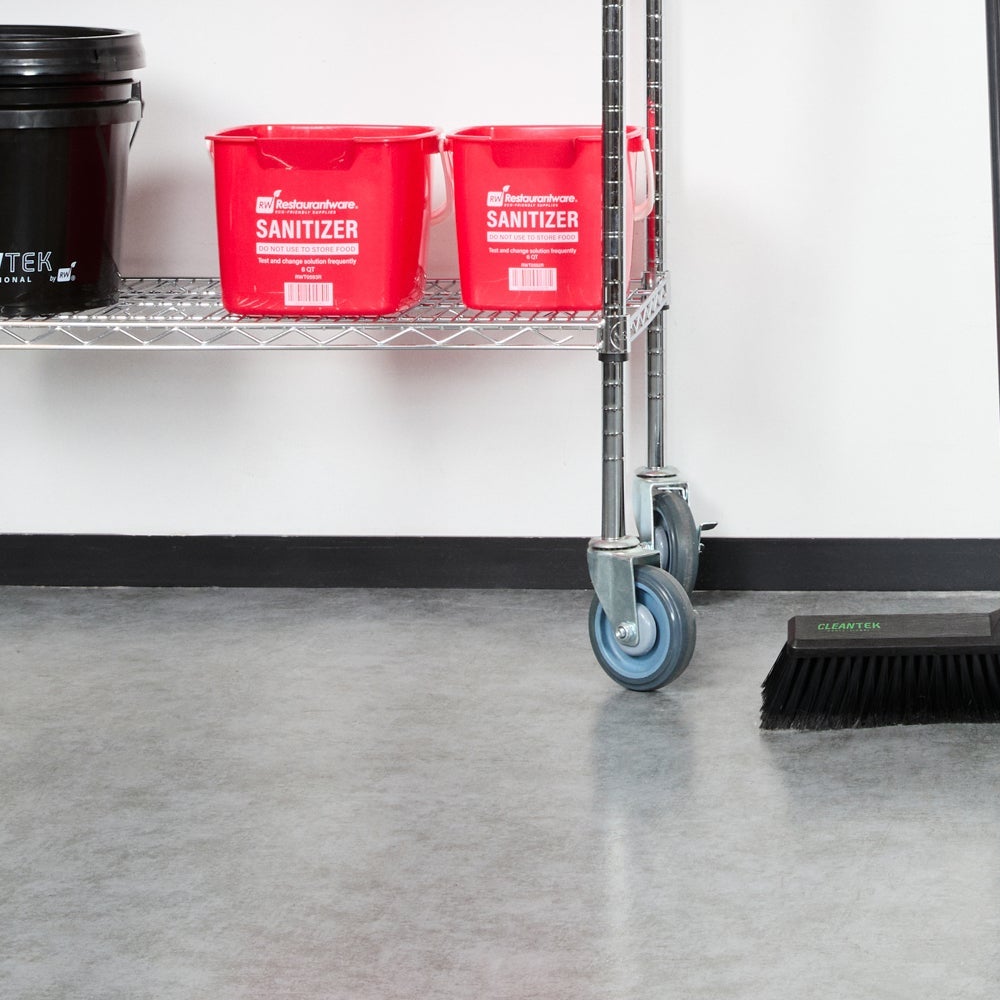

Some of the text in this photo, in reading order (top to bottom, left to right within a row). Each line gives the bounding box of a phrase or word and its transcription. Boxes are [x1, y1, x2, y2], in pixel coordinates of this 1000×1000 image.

[504, 193, 576, 203] Restaurantware
[276, 198, 356, 210] Restaurantware
[487, 210, 578, 228] SANITIZER
[256, 219, 358, 239] SANITIZER
[282, 258, 302, 266] change
[304, 257, 327, 265] solution
[328, 257, 357, 266] frequently
[49, 275, 56, 283] by
[818, 622, 880, 630] CLEANTEK
